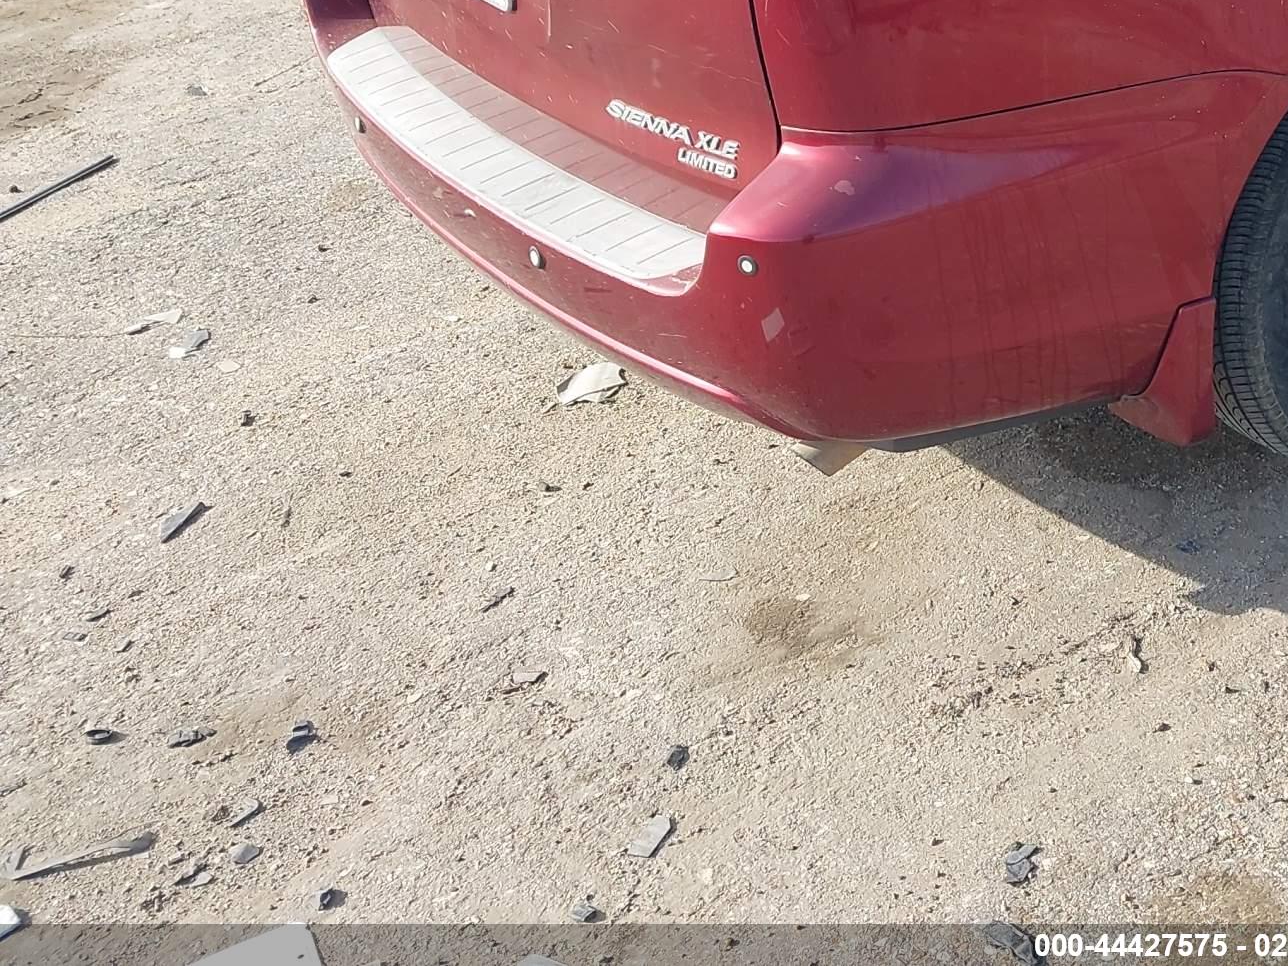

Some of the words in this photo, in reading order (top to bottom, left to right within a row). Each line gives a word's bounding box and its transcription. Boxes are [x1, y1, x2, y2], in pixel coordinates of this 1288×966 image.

[605, 99, 693, 146] SIENNA
[695, 130, 740, 160] XLE
[677, 147, 736, 179] LIMITED
